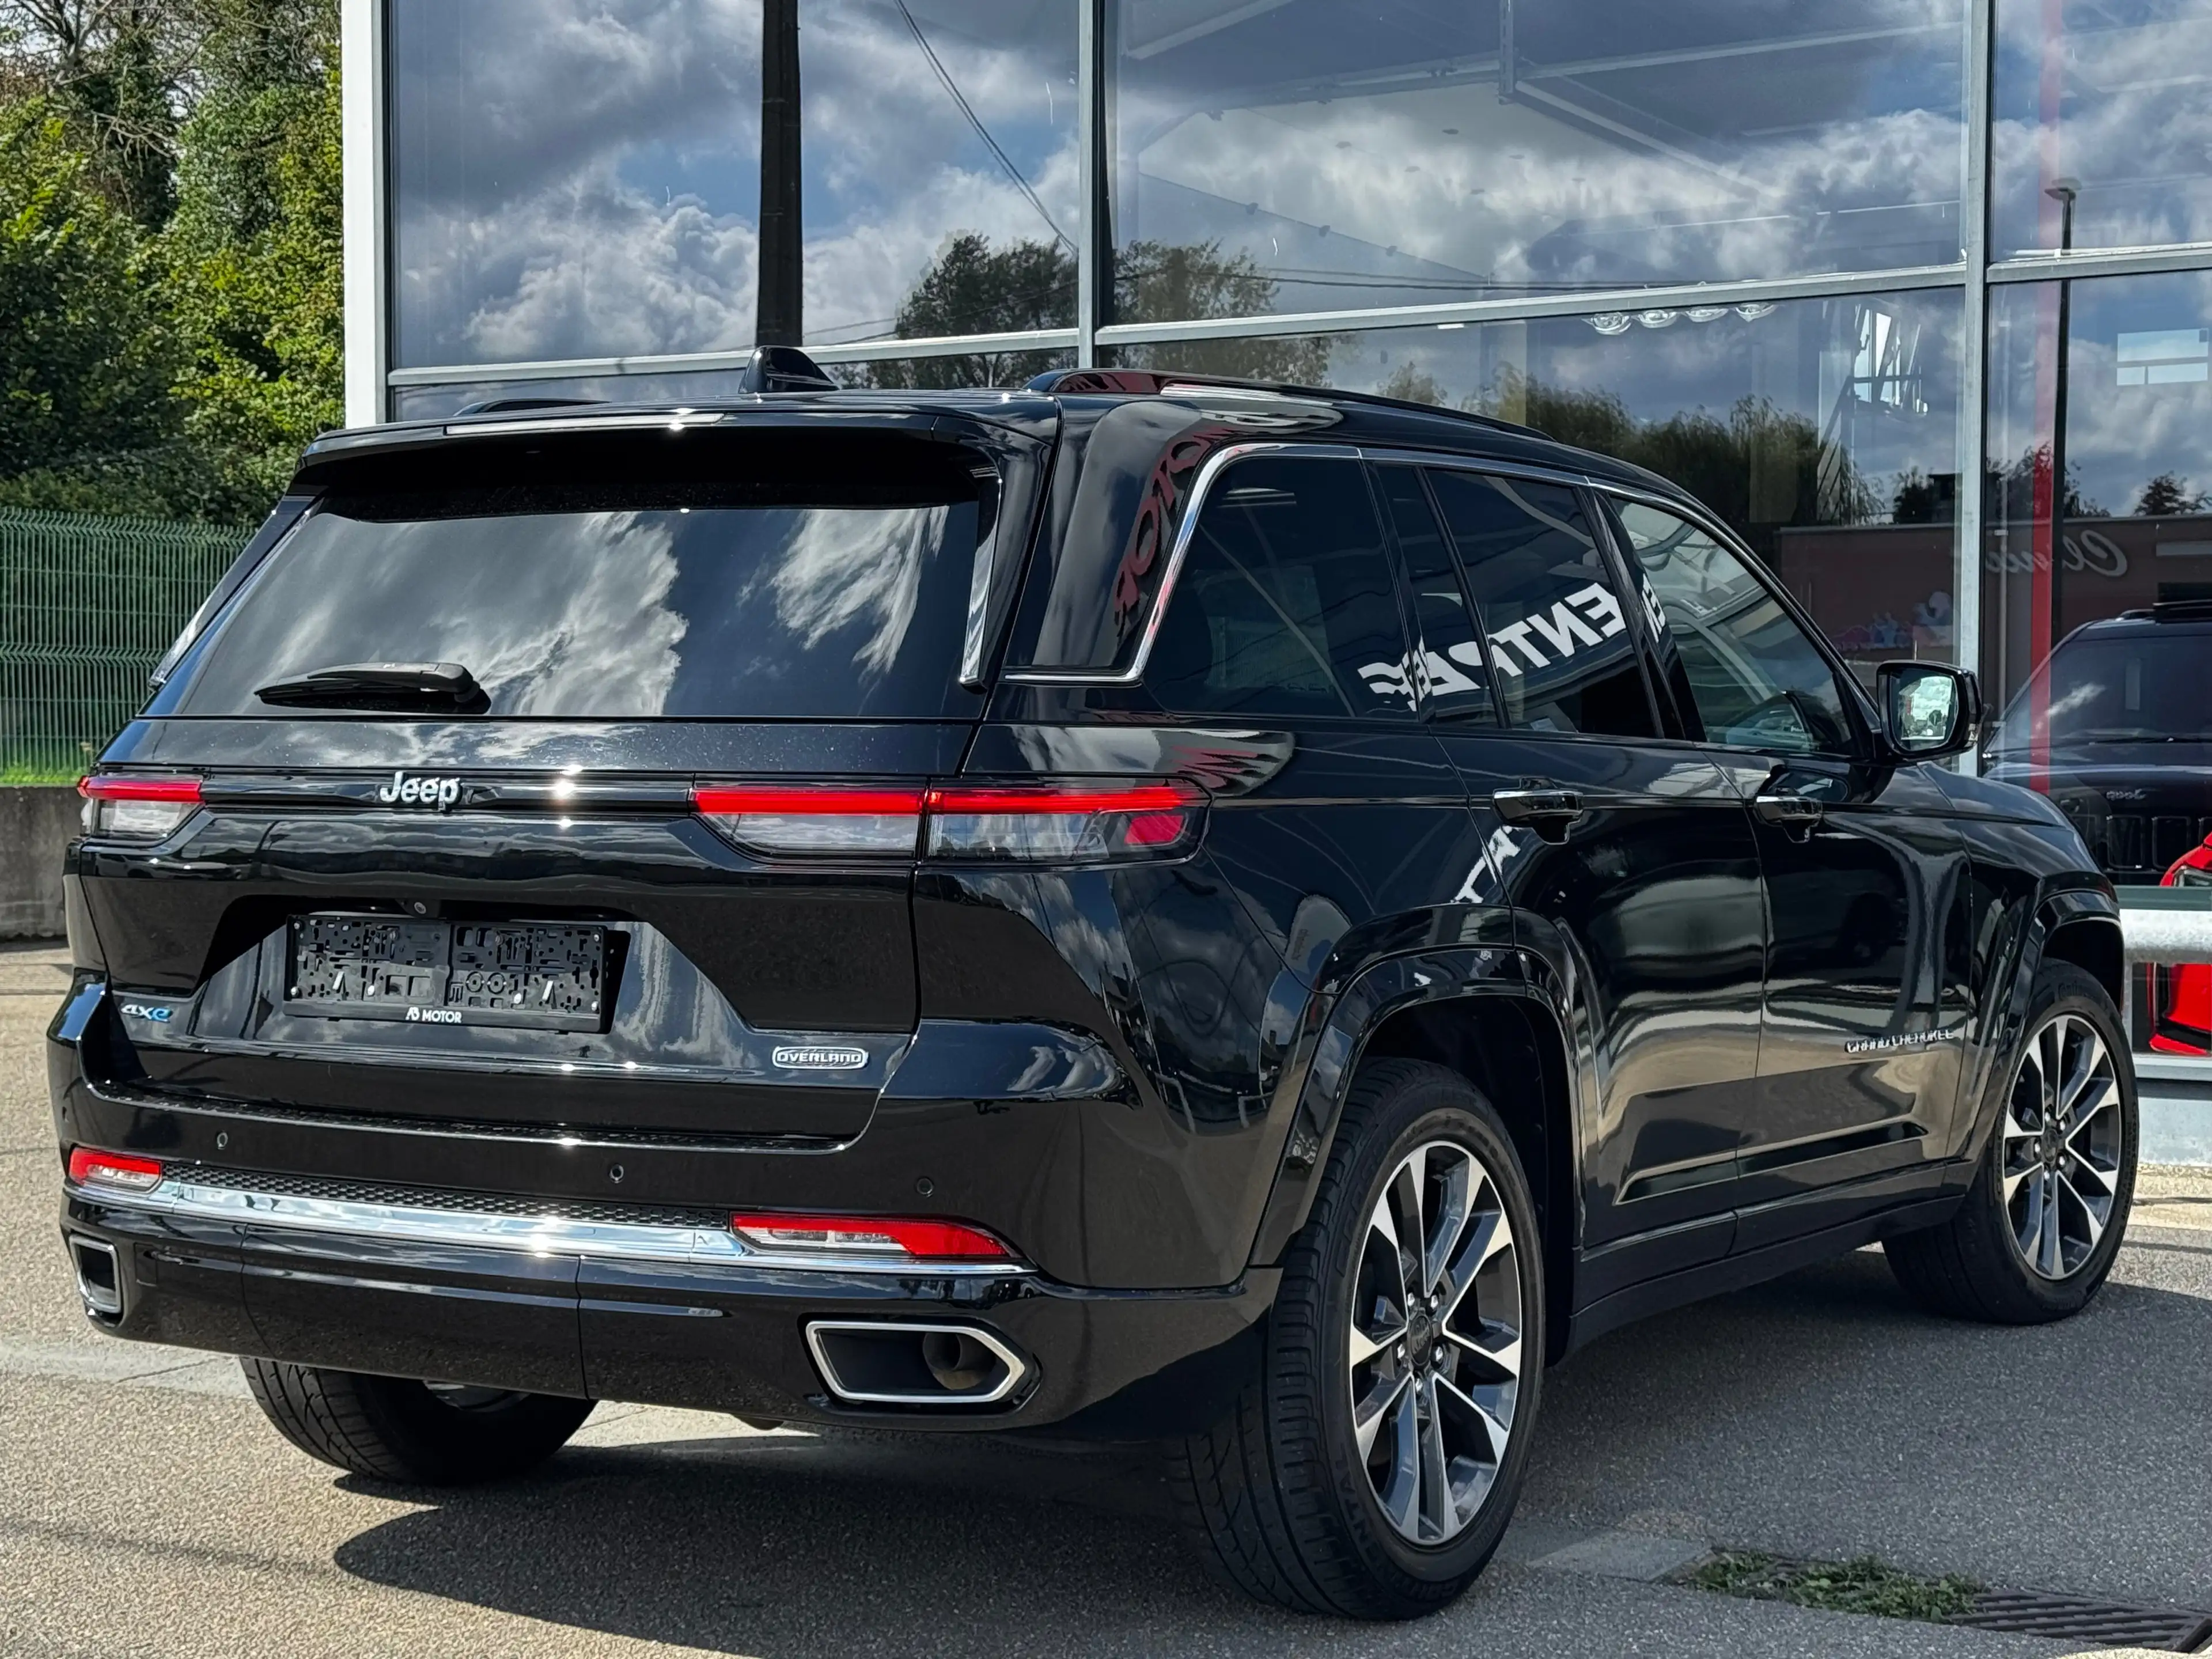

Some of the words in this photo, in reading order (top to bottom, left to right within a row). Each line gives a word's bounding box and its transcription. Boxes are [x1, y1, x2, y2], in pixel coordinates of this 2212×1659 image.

[380, 771, 460, 811] Jeep
[422, 1009, 462, 1024] MOTOR
[777, 1052, 863, 1063] OVERLAND
